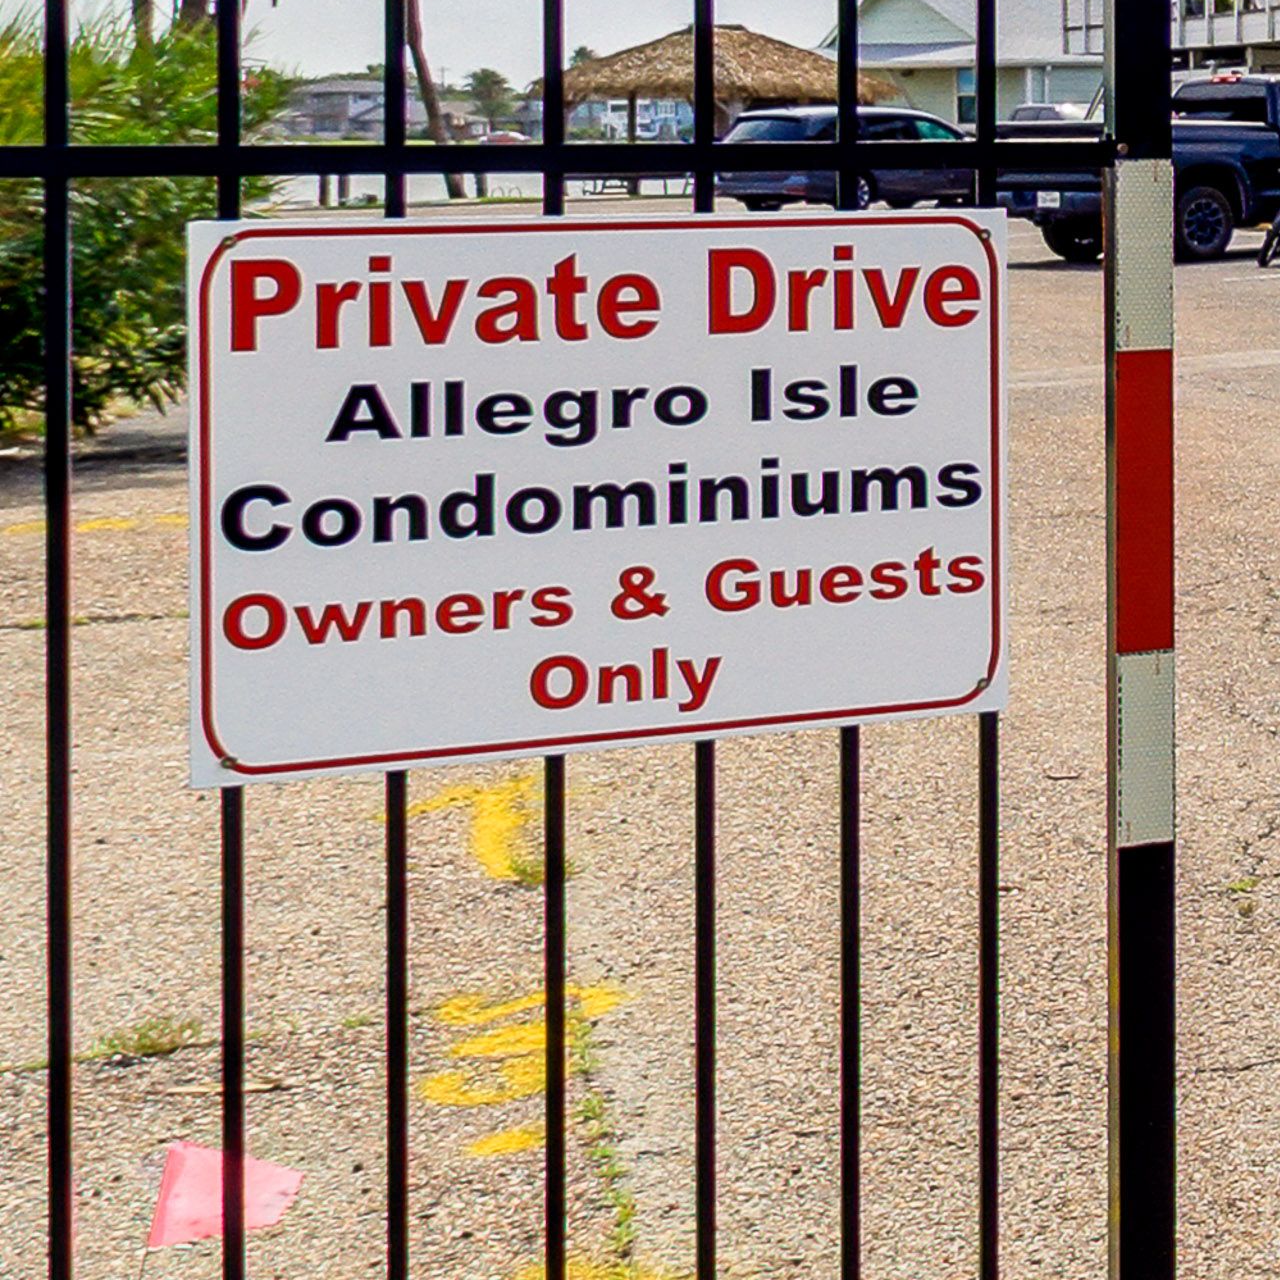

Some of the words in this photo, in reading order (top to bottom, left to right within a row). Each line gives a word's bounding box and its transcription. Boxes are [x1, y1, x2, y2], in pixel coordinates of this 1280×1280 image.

[229, 253, 662, 352] Private
[706, 244, 982, 336] Drive
[324, 379, 709, 448] Allegro
[750, 364, 919, 422] Isle
[219, 456, 983, 553] Condominiums
[221, 585, 574, 651] Owners
[609, 565, 670, 621] &
[704, 547, 986, 613] Guests
[528, 647, 722, 713] Only
